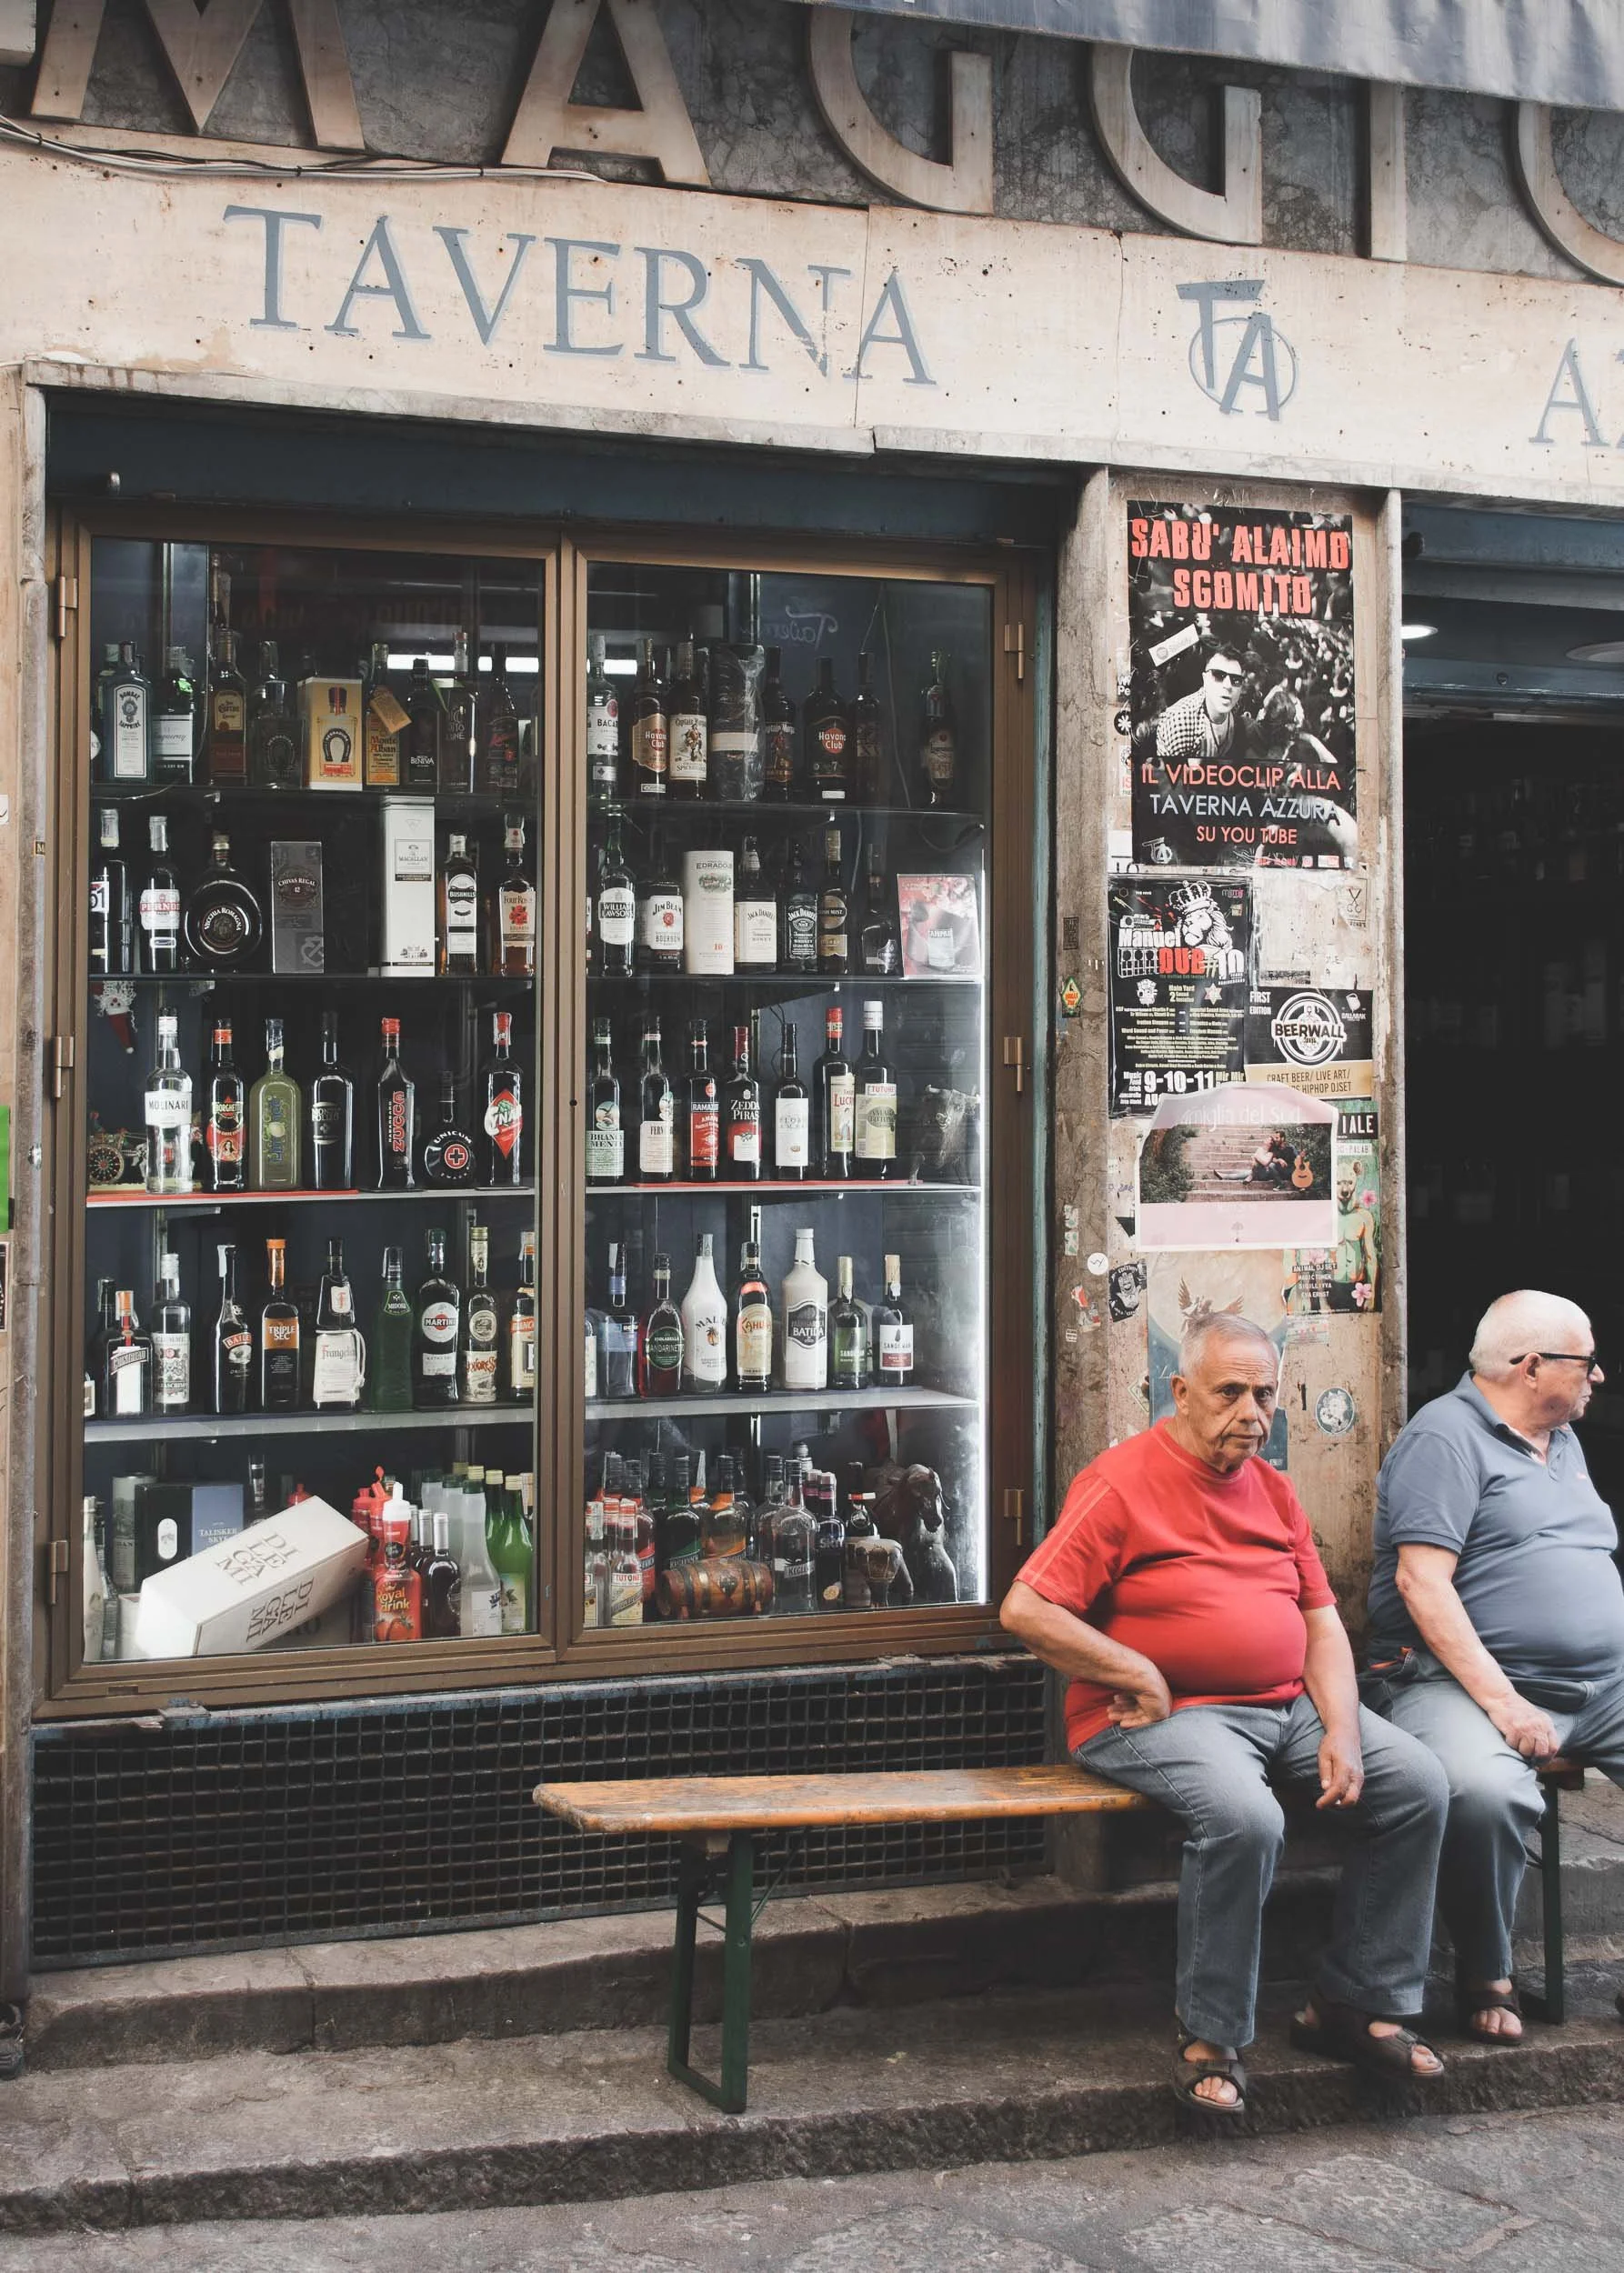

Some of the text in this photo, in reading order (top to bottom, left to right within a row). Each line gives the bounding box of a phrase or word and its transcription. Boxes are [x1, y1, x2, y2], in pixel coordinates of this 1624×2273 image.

[223, 205, 937, 386] TAVERNA
[1529, 337, 1624, 447] A
[1232, 525, 1349, 570] ALAIMO
[1173, 568, 1312, 615] SGOMITO
[119, 690, 141, 701] BOMBAY
[119, 718, 141, 729] SAPPHIRE
[825, 740, 843, 750] Club
[1141, 764, 1342, 790] IL VIDEOCLIP ALLA
[1149, 794, 1252, 817] TAVERNA
[1197, 826, 1298, 846] SU YOU TUBE
[277, 877, 317, 887] CHIVAS REGAL
[653, 903, 666, 916] JIM
[787, 908, 800, 921] JACK
[1118, 927, 1182, 947] Manuel
[1249, 991, 1271, 1004] FIRST
[1249, 1006, 1271, 1015] EDITION
[1275, 1023, 1344, 1038] BEERWALL
[1144, 1070, 1214, 1093] 9-10-11
[1316, 1070, 1331, 1081] LIVE
[1302, 1083, 1328, 1093] HIPHOP
[148, 1099, 189, 1110] MOLINARI
[730, 1099, 760, 1110] ZEDDA
[392, 1090, 405, 1152] ZUCCA
[733, 1109, 760, 1120] PIRAS
[433, 1130, 473, 1144] UNICUM
[269, 1325, 296, 1335] TRIPLE
[199, 1528, 238, 1537] TALISKER
[378, 1587, 406, 1603] Royal
[381, 1598, 410, 1613] drink
